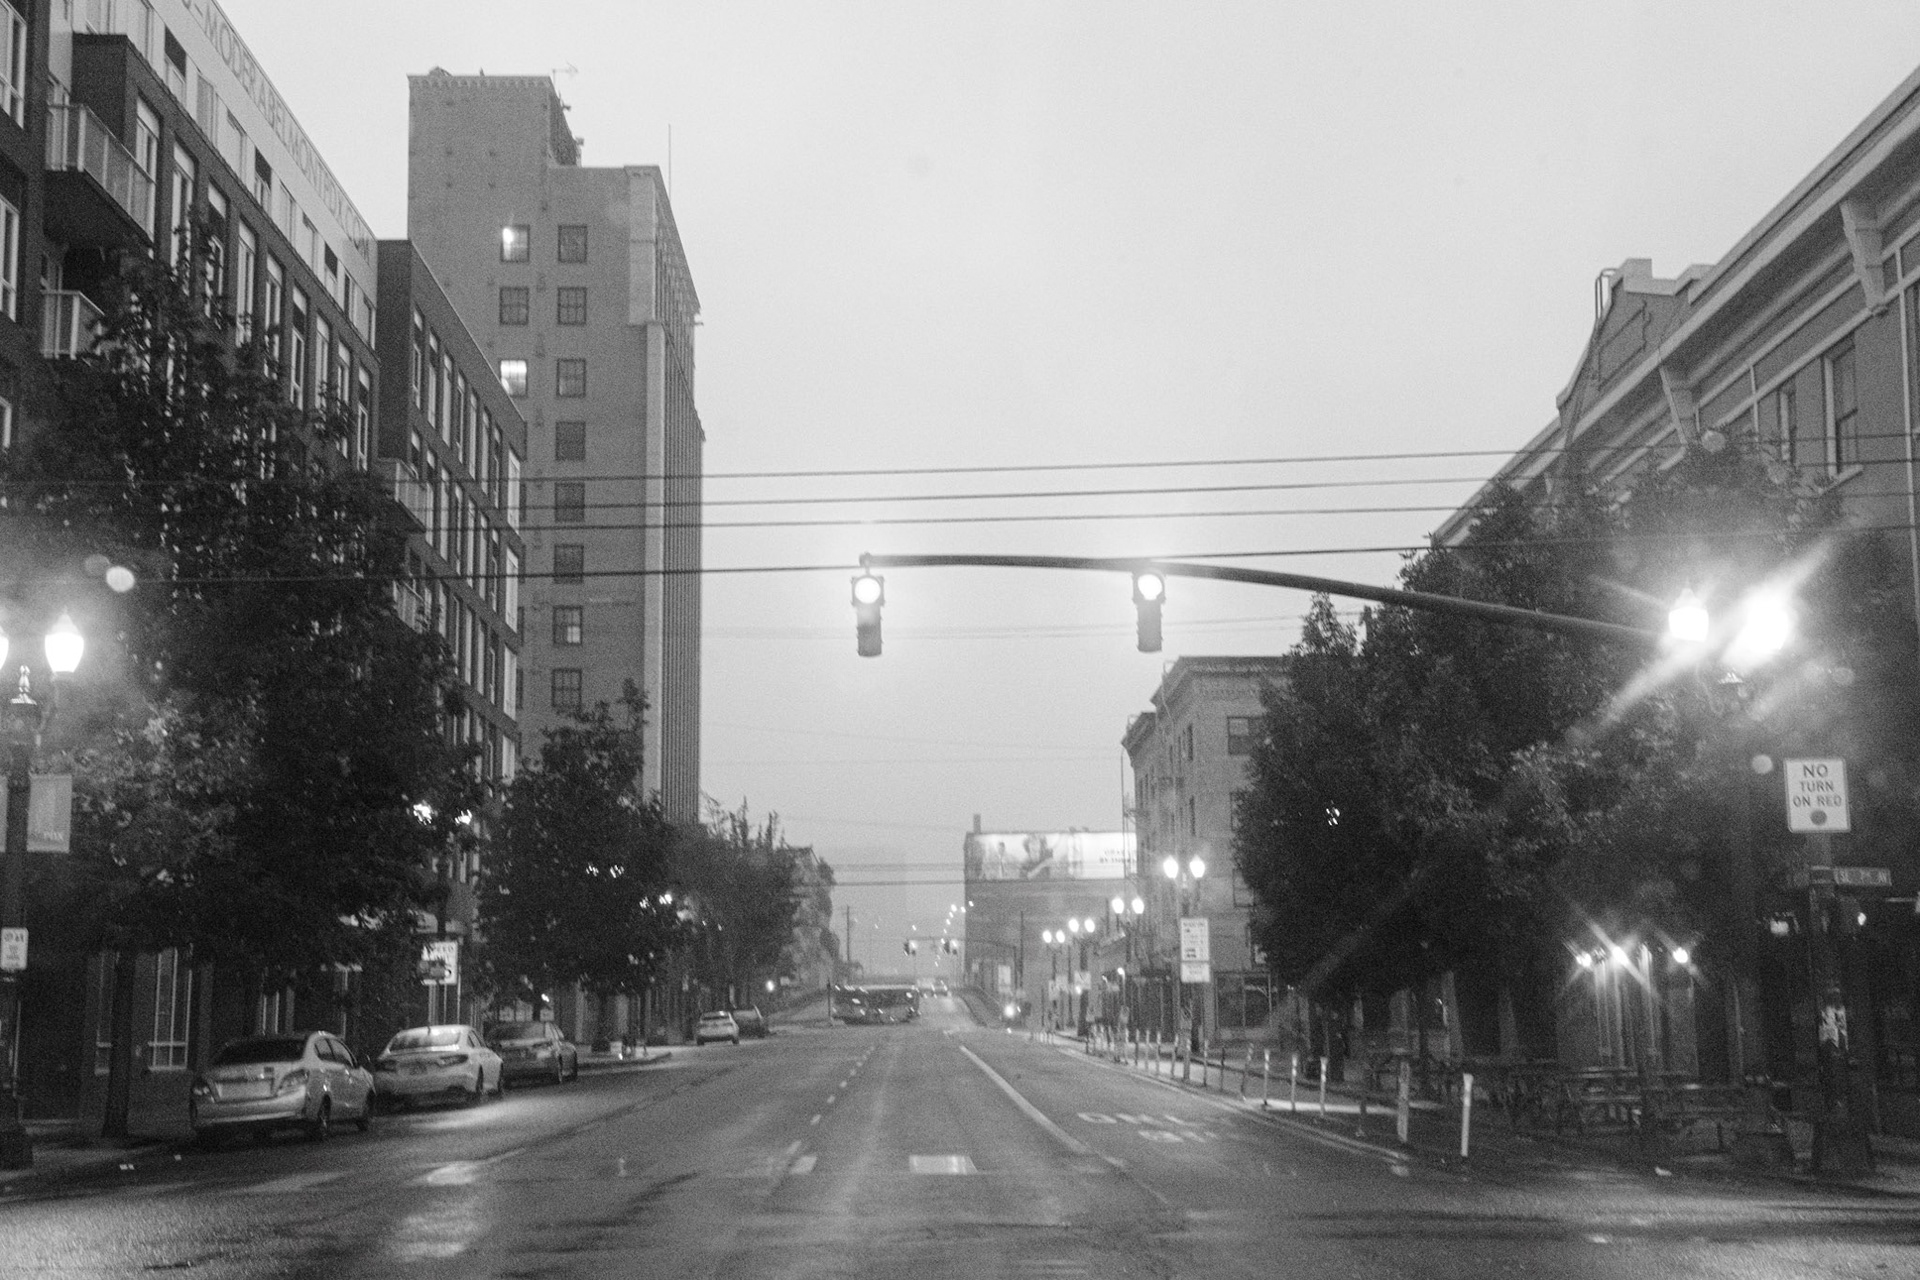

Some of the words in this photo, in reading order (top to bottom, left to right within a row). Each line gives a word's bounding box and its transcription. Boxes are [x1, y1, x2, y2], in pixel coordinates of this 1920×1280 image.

[1802, 763, 1829, 779] NO
[1800, 780, 1835, 793] TURN
[1792, 795, 1811, 808] ON
[1816, 794, 1843, 808] RED
